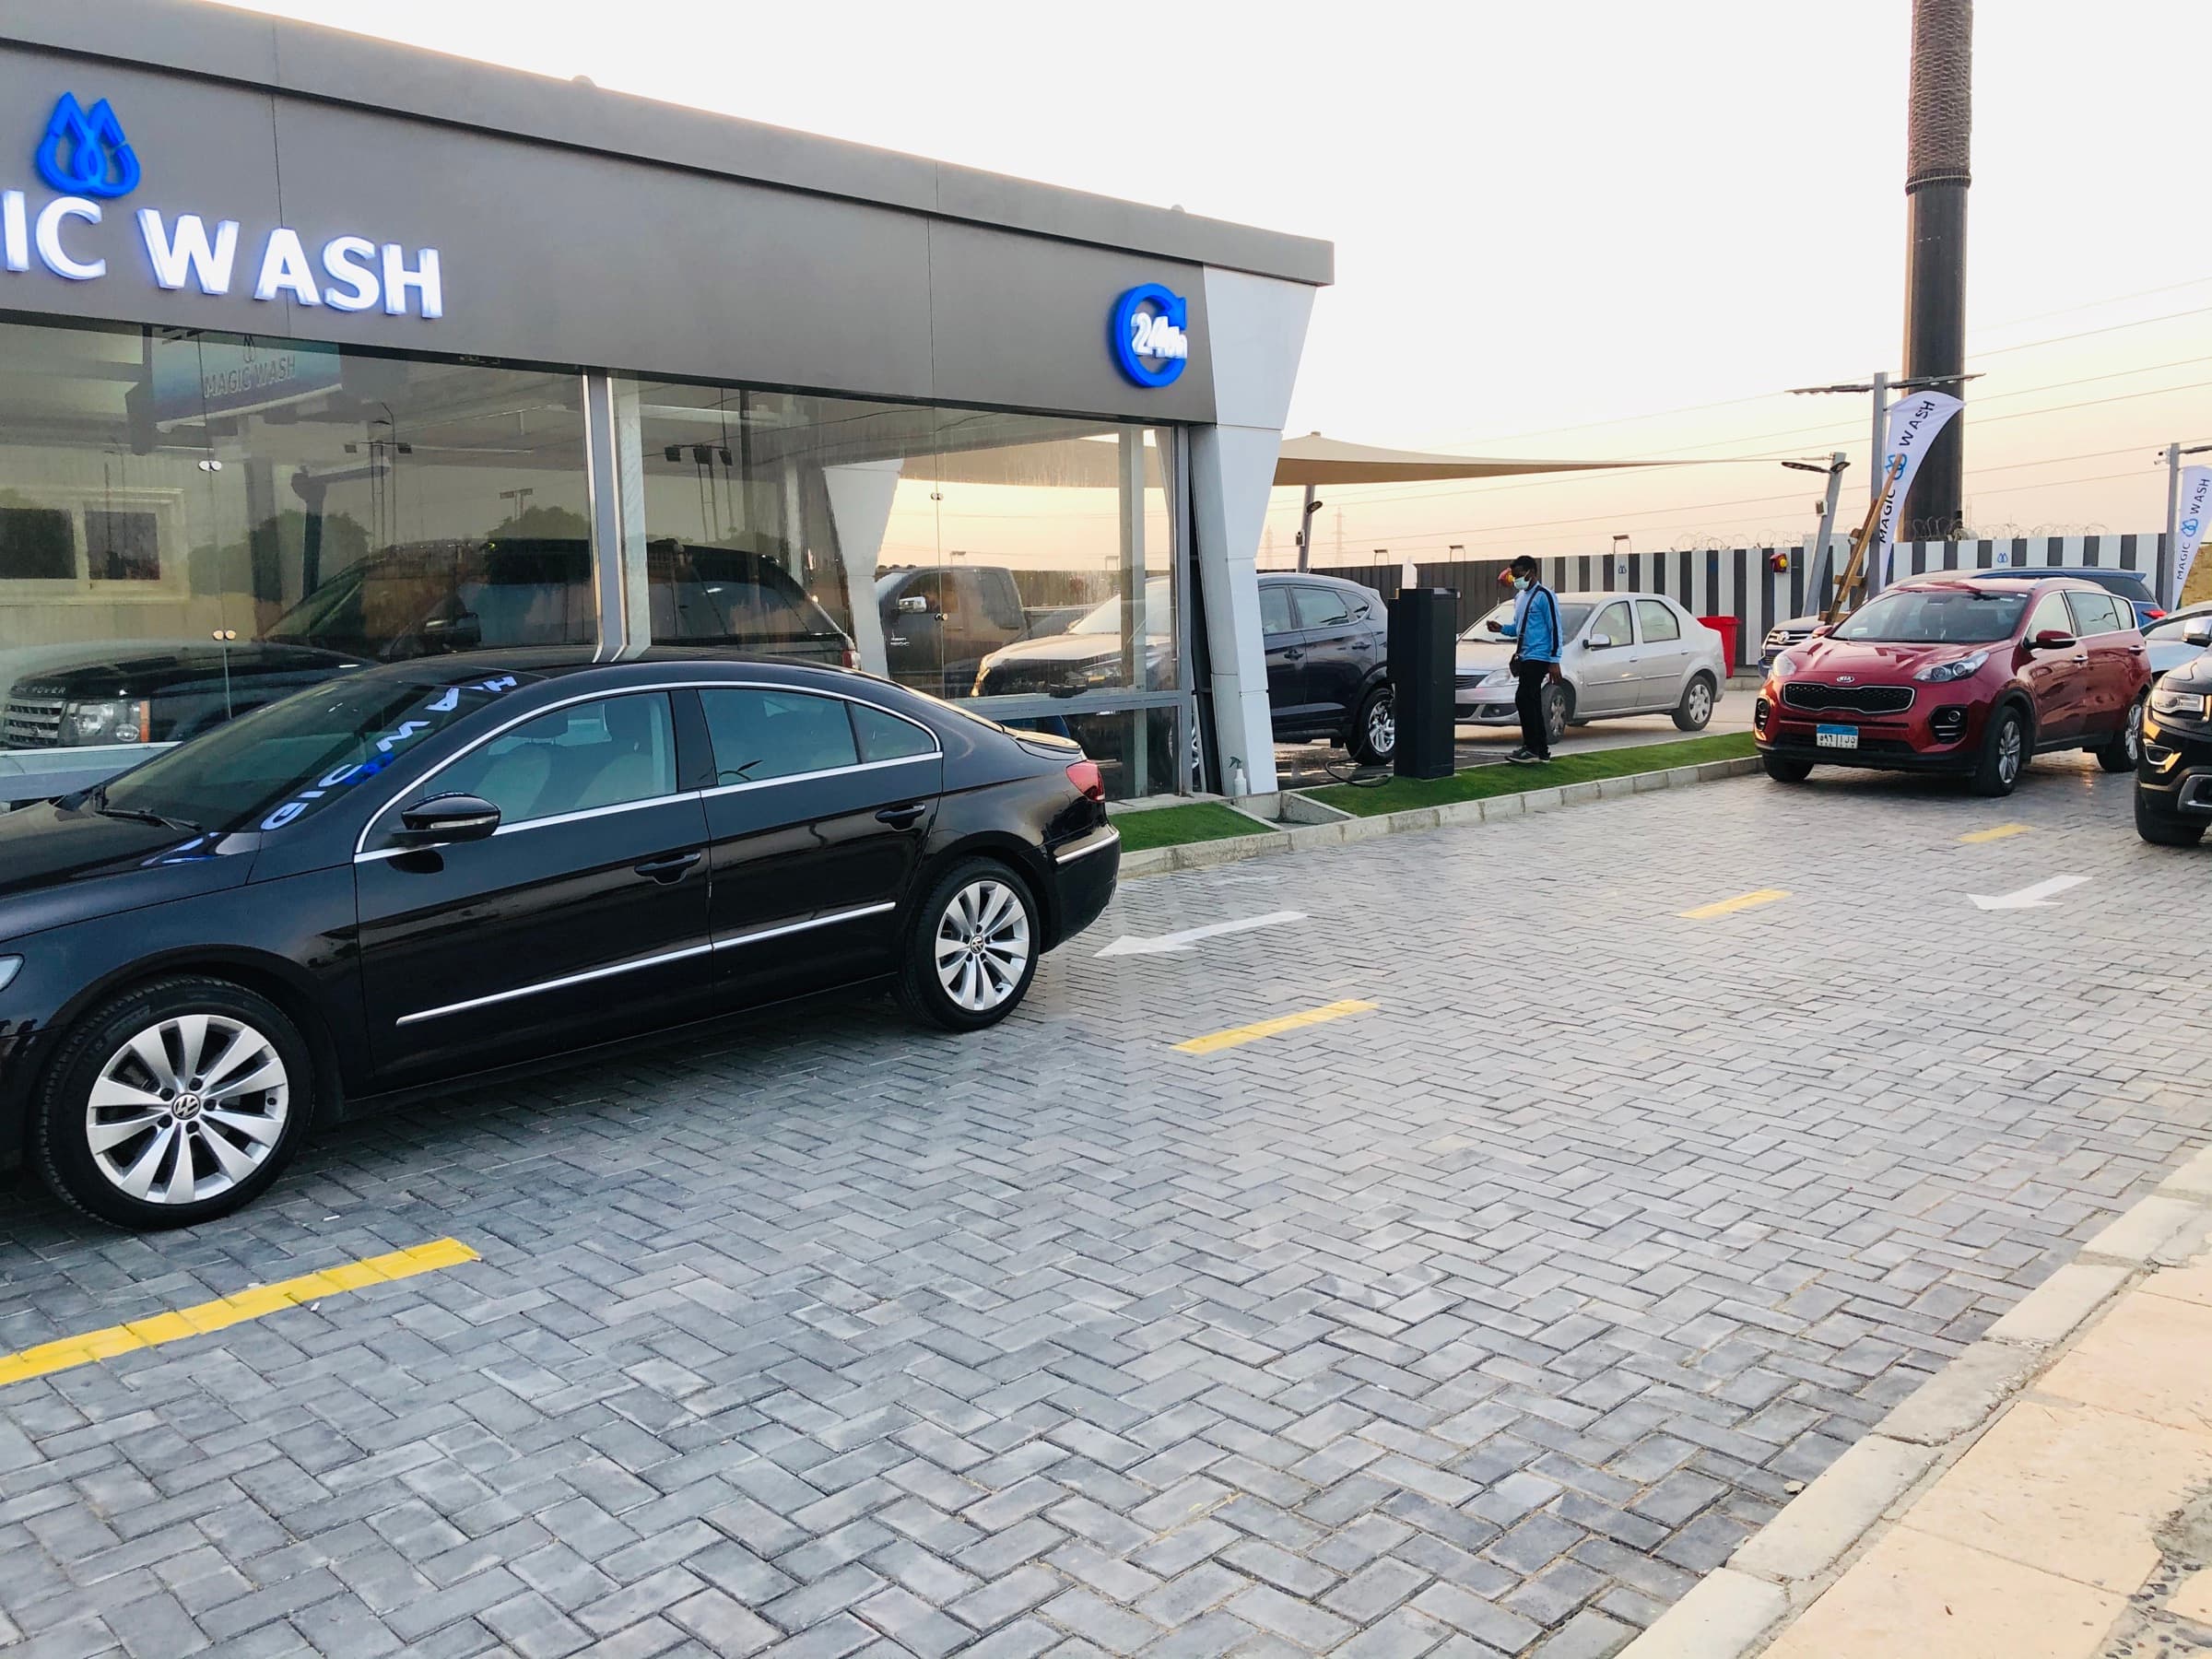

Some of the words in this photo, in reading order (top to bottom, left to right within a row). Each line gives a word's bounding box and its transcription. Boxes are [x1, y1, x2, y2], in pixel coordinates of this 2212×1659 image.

[137, 208, 443, 319] WASH
[204, 367, 252, 399] MAGIC
[255, 355, 296, 388] WASH
[1879, 488, 1896, 544] MAGIC
[1899, 400, 1936, 447] WASH
[2177, 542, 2191, 580] MAGIC
[2189, 478, 2211, 515] WASH
